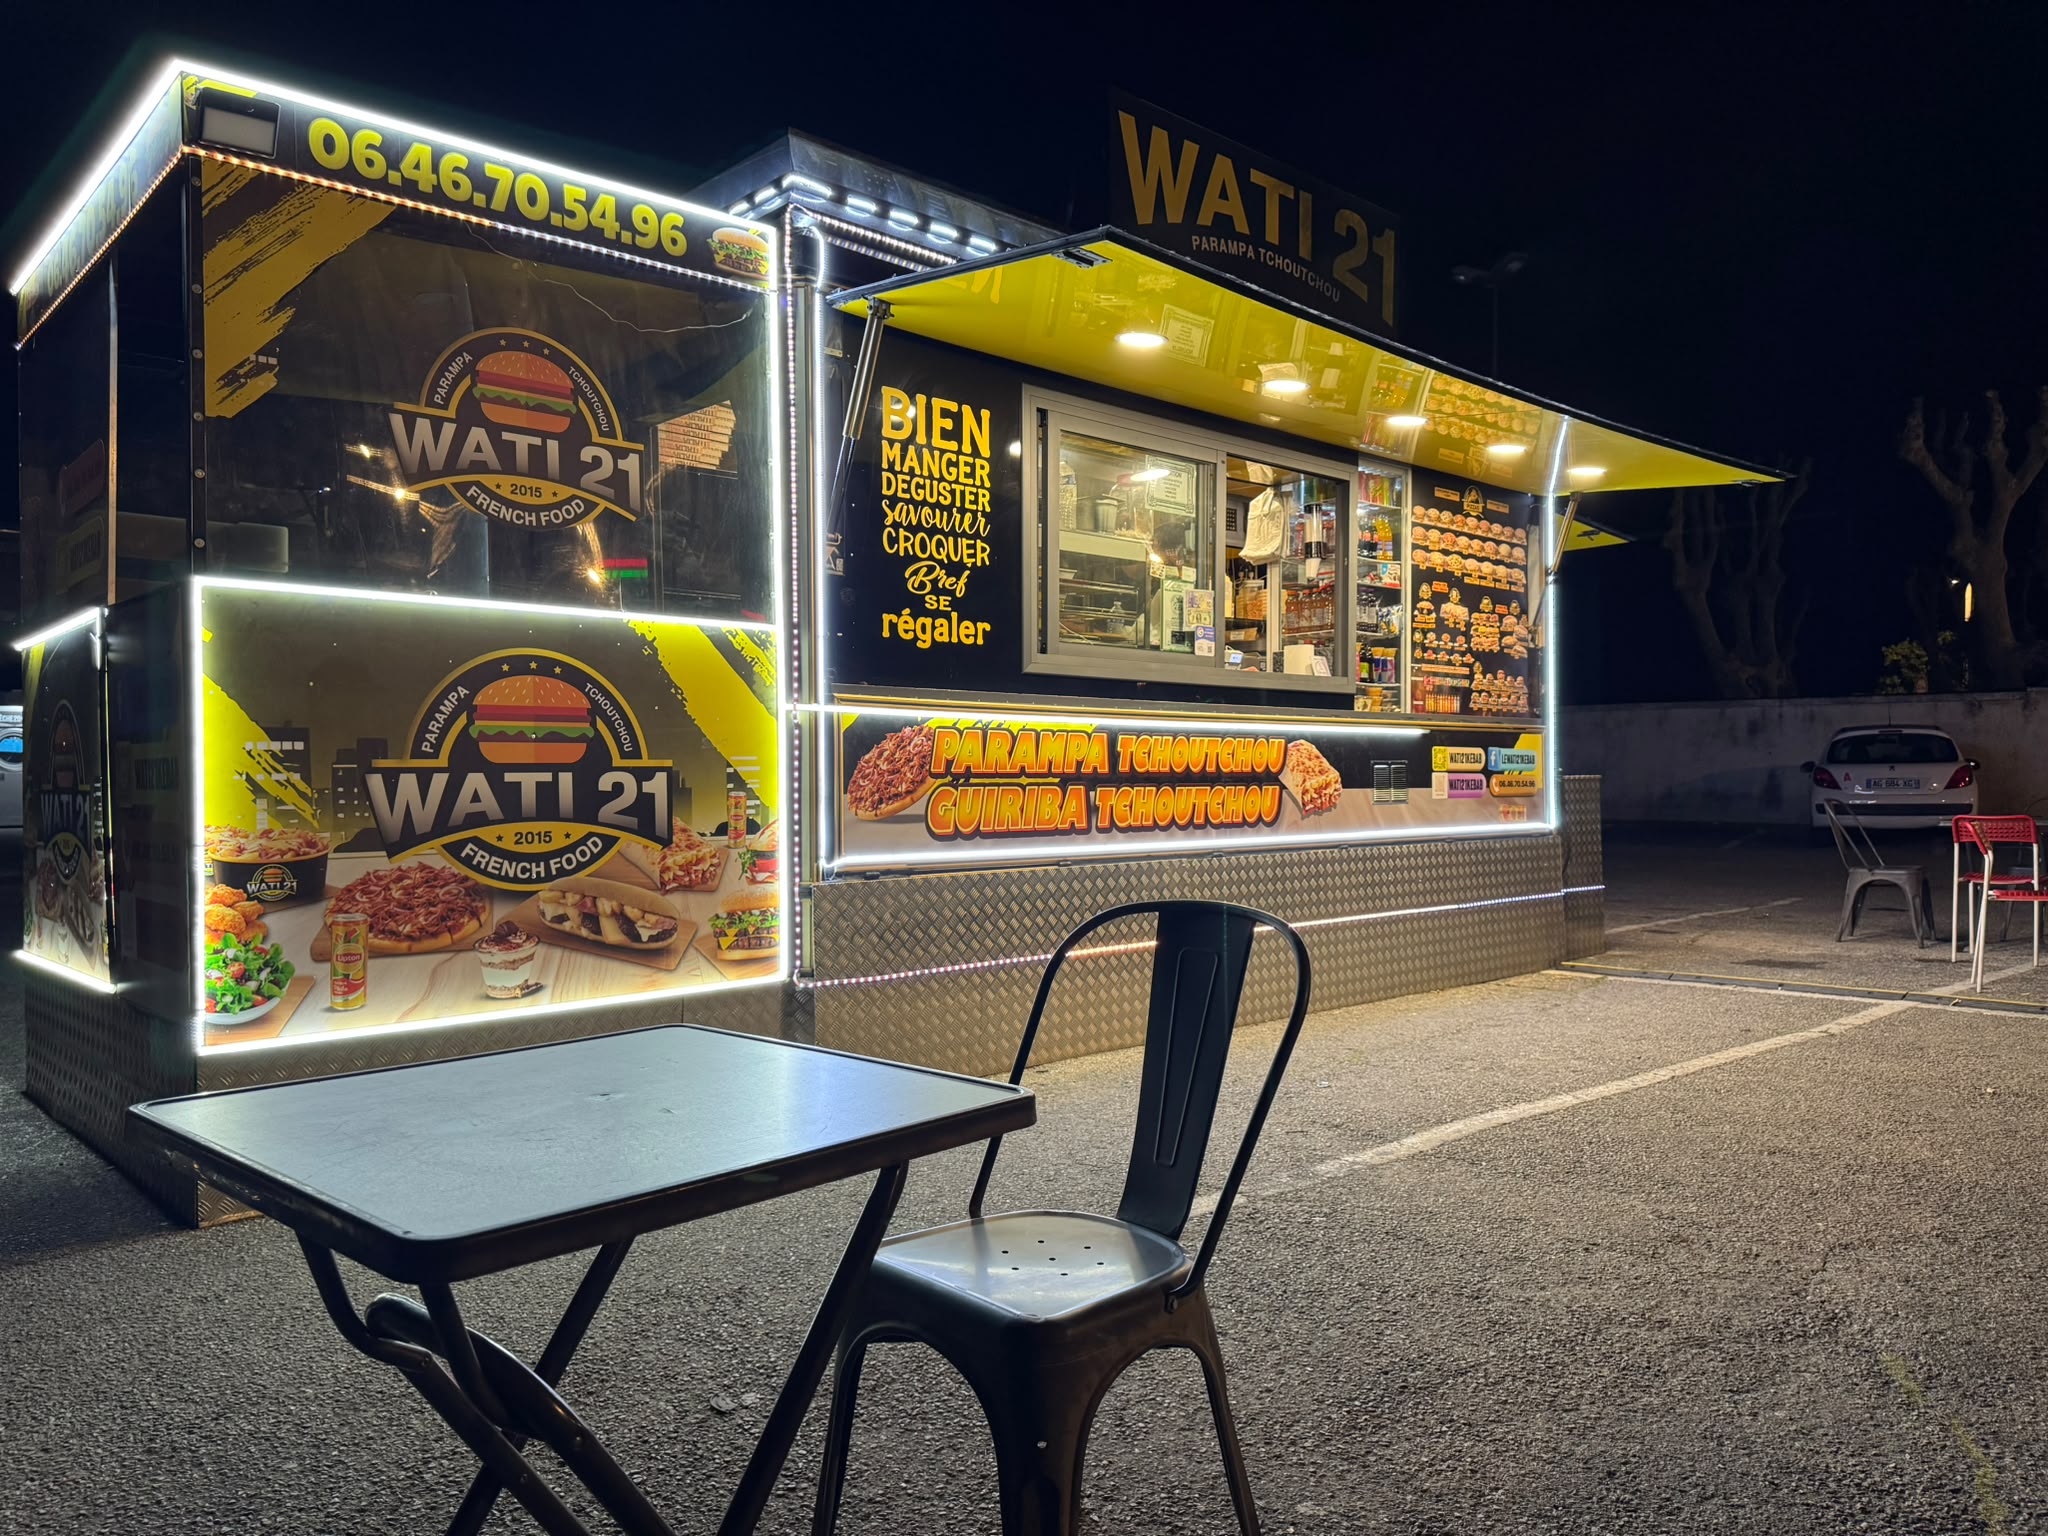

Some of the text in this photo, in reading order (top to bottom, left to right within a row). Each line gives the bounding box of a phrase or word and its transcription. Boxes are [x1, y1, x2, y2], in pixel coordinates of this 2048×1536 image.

[308, 117, 688, 257] 06.46.70.54.96
[1118, 110, 1396, 328] WATI 21
[1191, 235, 1341, 303] PARAMPA TCHOUTCHOU
[433, 351, 473, 405] PARAMPA
[568, 366, 610, 432] TCHOUTCHOU
[880, 385, 991, 459] BIEN
[388, 412, 641, 514] WATI 21
[881, 439, 991, 488] MANGER
[465, 485, 586, 528] FRENCH FOOD
[509, 483, 543, 499] 2015
[881, 471, 991, 513] DEGUSTER
[881, 499, 991, 537] savourer
[882, 527, 991, 567] CROQUER
[904, 560, 971, 598] Bref
[924, 595, 952, 611] SE
[882, 607, 991, 649] régaler
[421, 685, 470, 753] PARAMPA
[584, 682, 633, 752] TCHOUTCHOU
[931, 728, 1286, 775] PARAMPA TCHOUTCHOU
[365, 770, 668, 846] WATI 21
[926, 784, 1281, 836] GUIRIBA TCHOUTCHOU
[459, 835, 604, 879] FRENCH FOOD
[513, 830, 553, 846] 2015
[246, 882, 281, 895] WATI
[337, 954, 361, 963] Lipton
